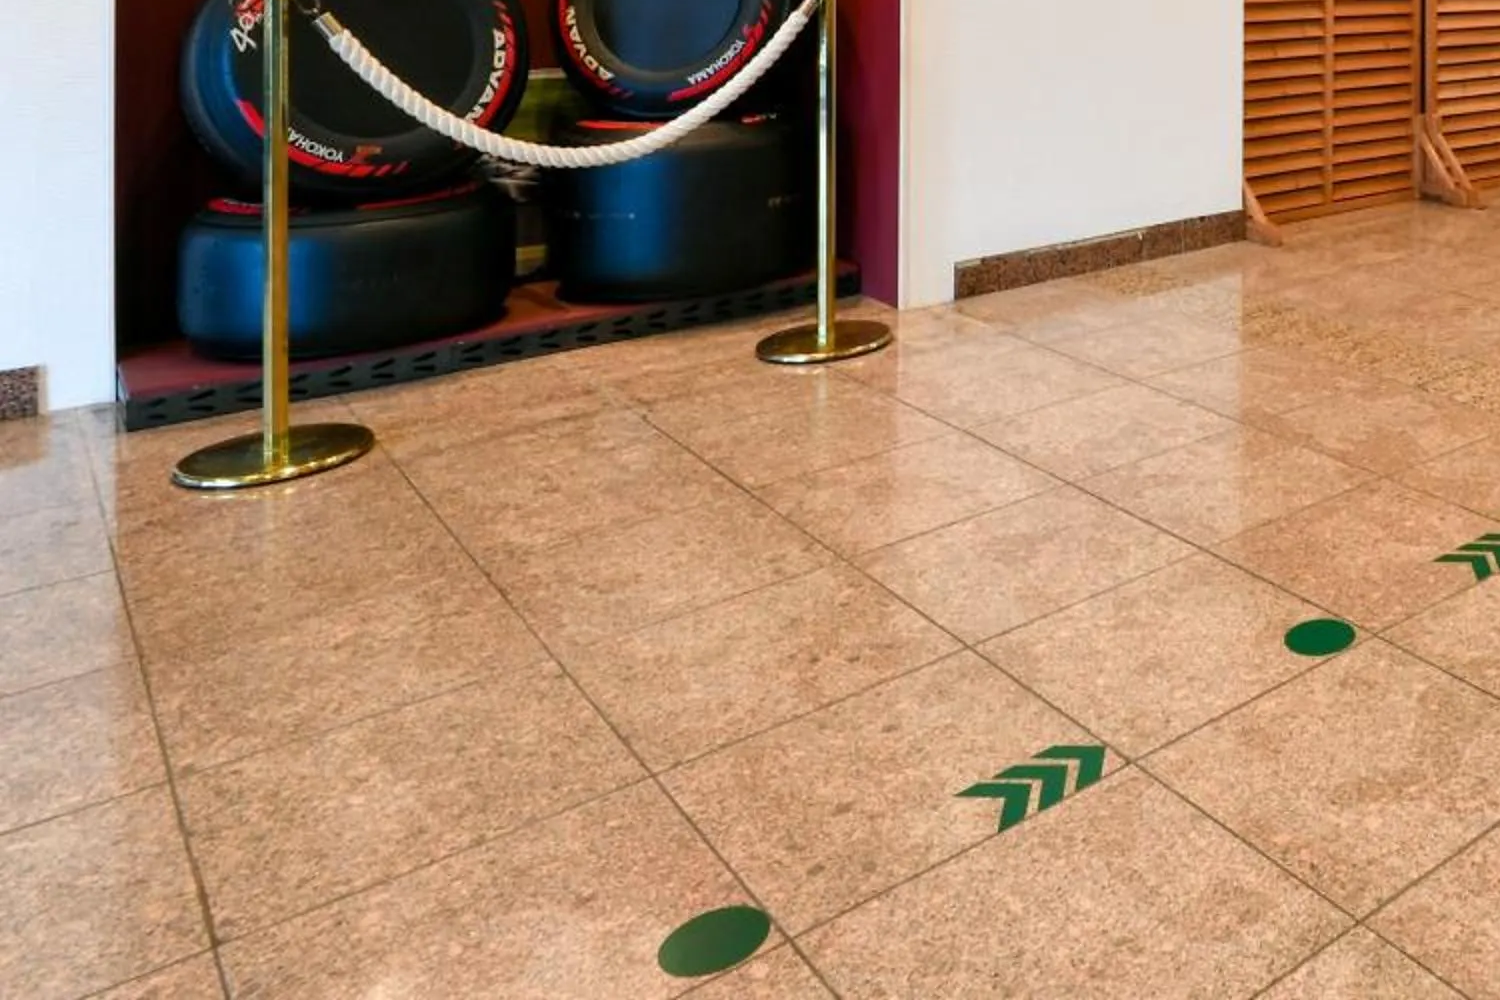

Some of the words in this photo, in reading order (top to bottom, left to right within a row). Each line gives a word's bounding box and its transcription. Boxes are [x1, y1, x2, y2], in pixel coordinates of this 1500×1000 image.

[565, 5, 616, 82] ADVAN
[687, 38, 746, 86] YOKOHAMA
[287, 126, 345, 163] YOKOHA
